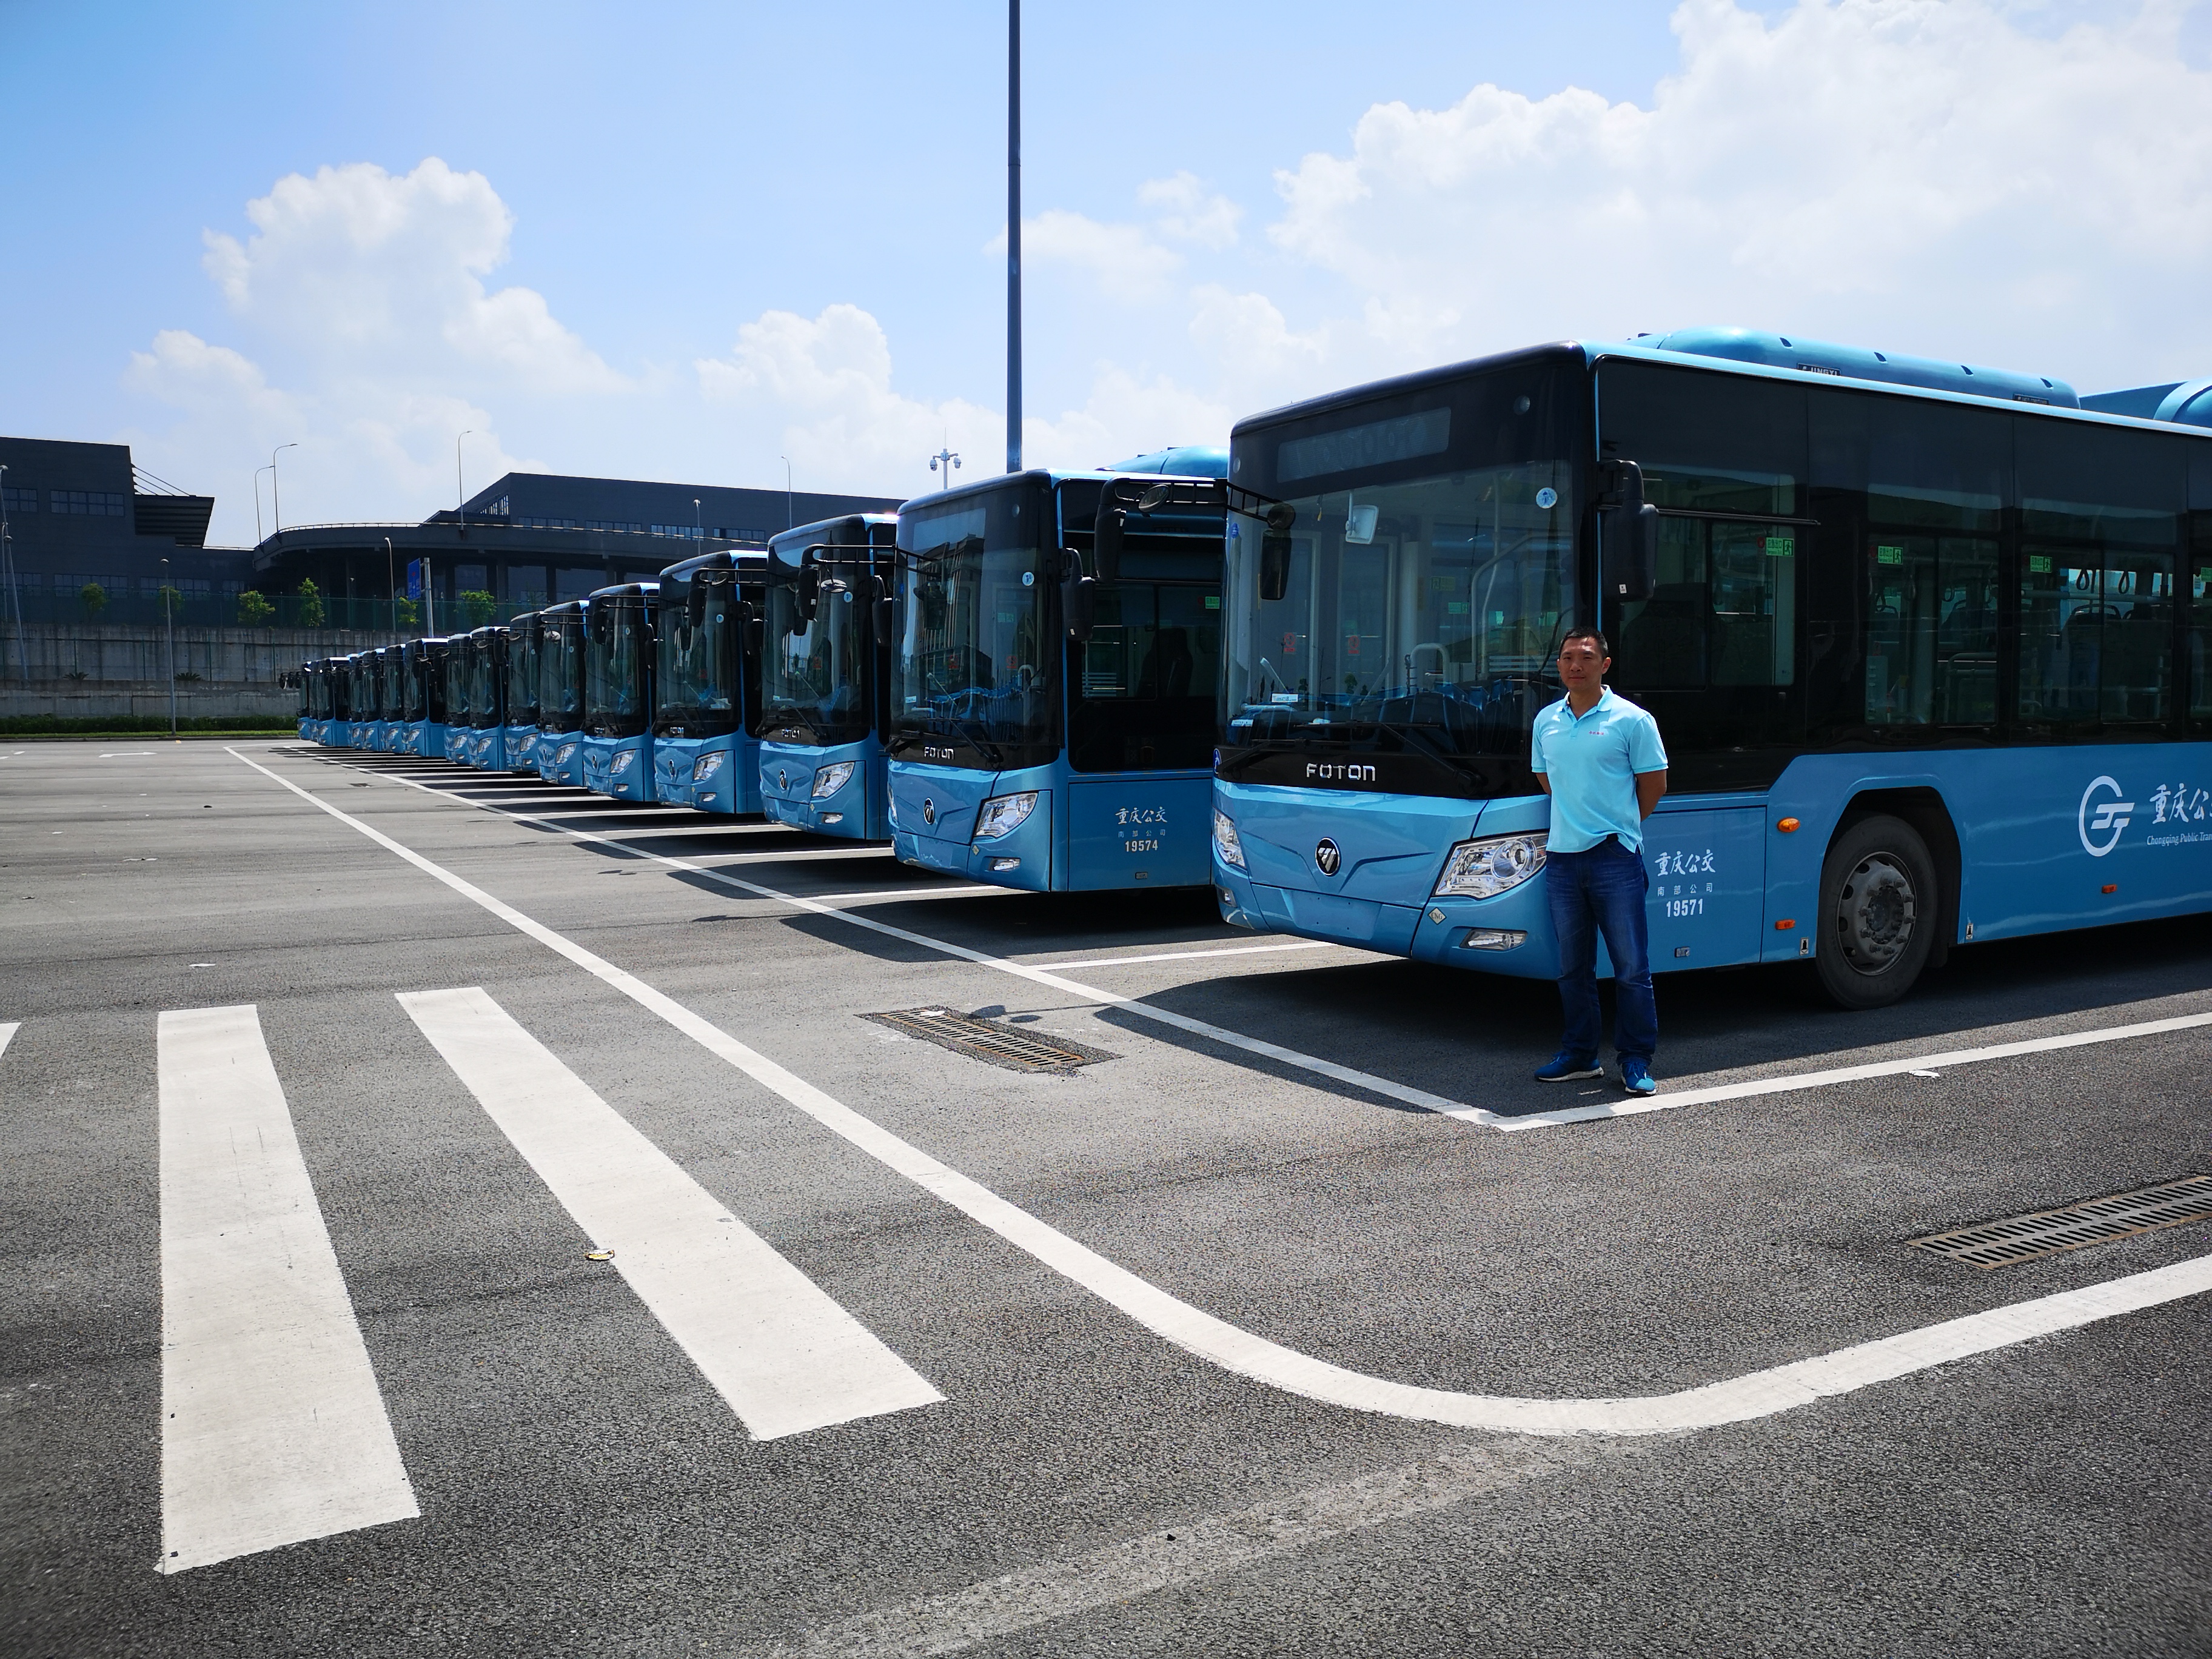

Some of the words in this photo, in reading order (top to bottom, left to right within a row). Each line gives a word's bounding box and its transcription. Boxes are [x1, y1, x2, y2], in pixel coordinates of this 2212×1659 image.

[1306, 763, 1376, 782] FOTON
[2149, 783, 2212, 824] 重庆公
[1115, 806, 1168, 825] 重庆公交
[1125, 839, 1158, 853] 19574
[2147, 834, 2179, 846] Chongqing
[2180, 833, 2198, 843] Public
[1655, 849, 1716, 877] 重庆公交
[1657, 882, 1713, 897] 南部公司
[1666, 898, 1703, 917] 19571
